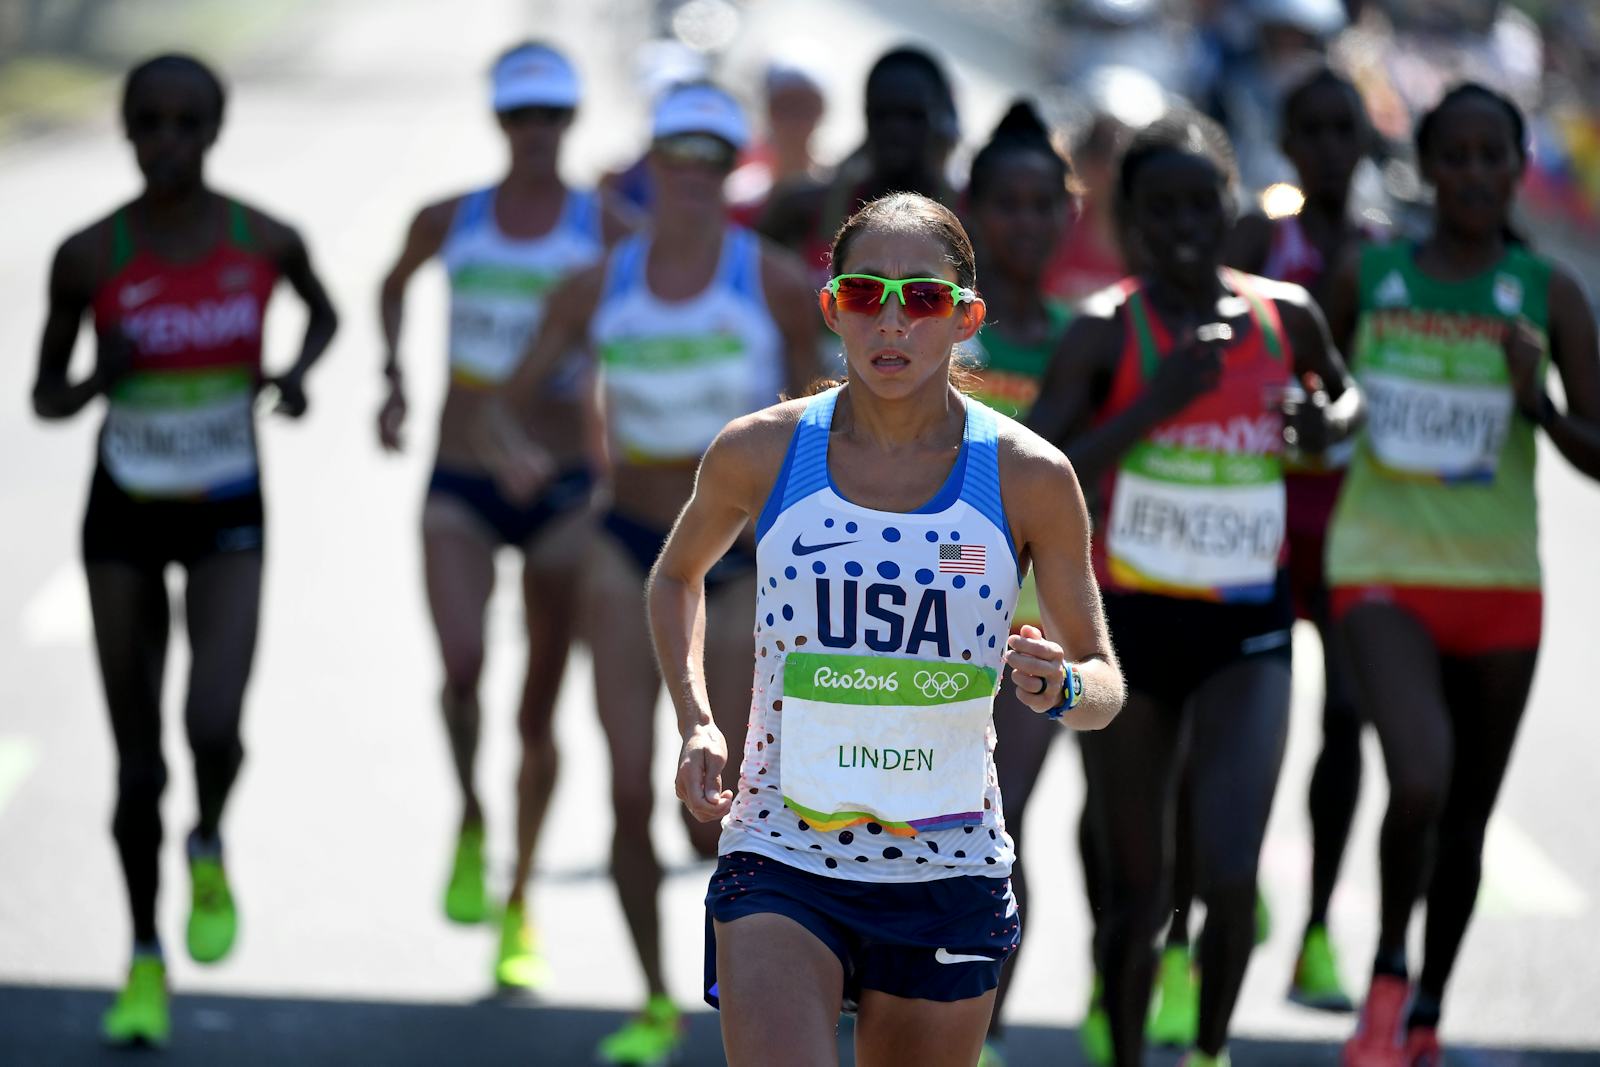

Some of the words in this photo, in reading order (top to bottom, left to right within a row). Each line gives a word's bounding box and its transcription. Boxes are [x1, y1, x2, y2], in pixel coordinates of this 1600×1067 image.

[815, 577, 951, 657] USA
[813, 666, 899, 692] Rio2016
[838, 744, 934, 771] LINDEN
